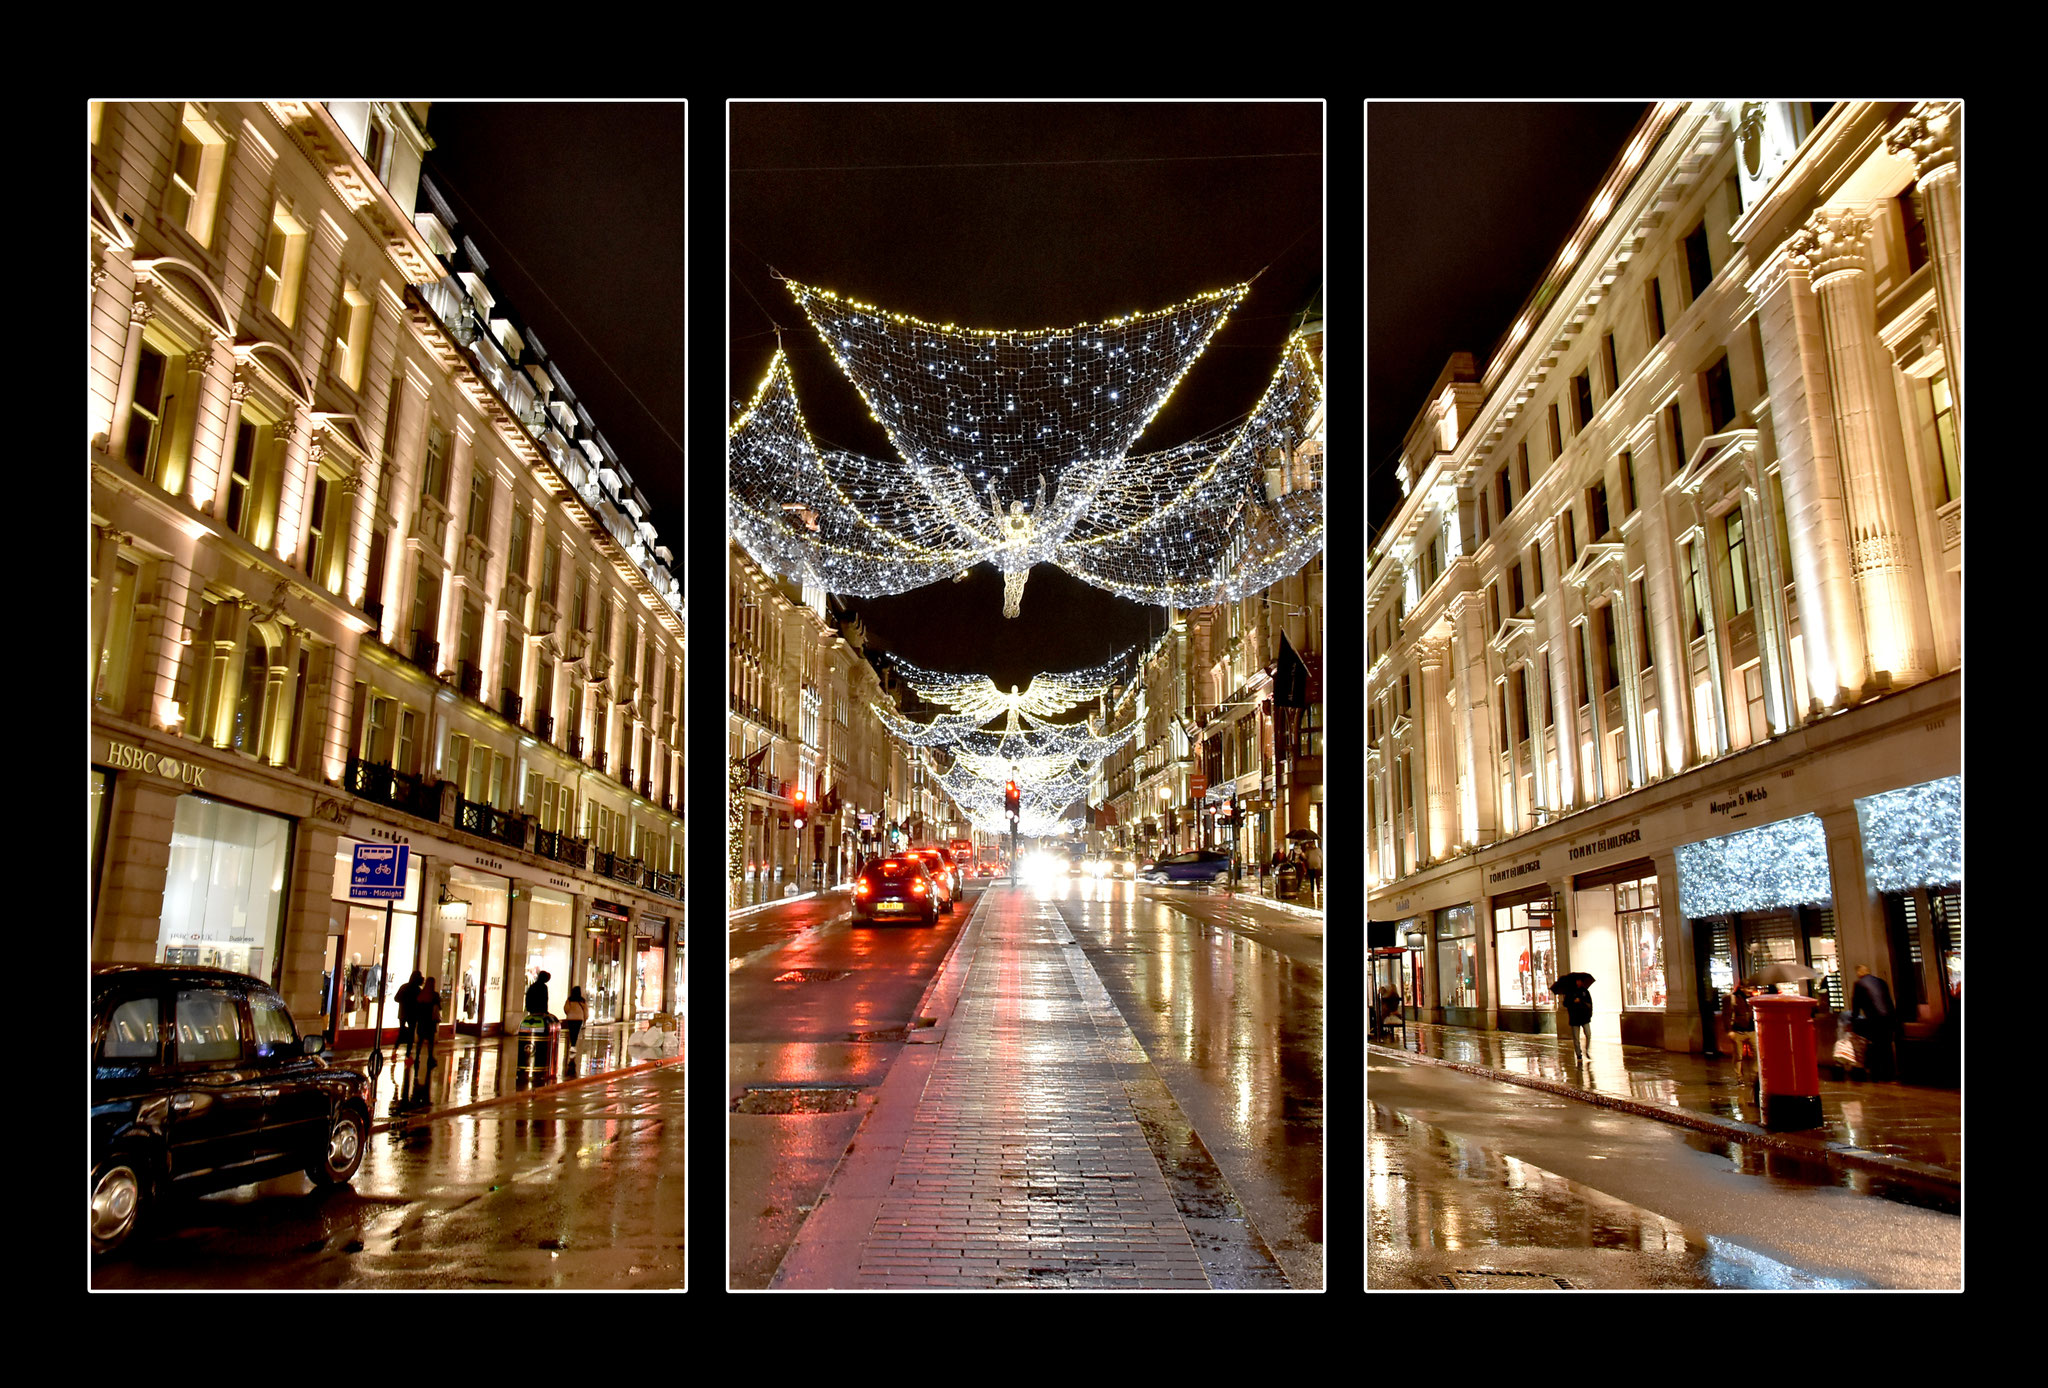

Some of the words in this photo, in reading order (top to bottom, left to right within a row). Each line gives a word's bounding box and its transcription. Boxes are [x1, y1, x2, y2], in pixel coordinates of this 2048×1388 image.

[107, 741, 157, 773] HSBC
[182, 762, 206, 788] UK
[1739, 793, 1745, 806] &
[1745, 786, 1768, 803] Webb
[371, 828, 409, 844] sandro
[1568, 841, 1597, 861] TOMMY
[1606, 828, 1641, 850] HILFIGER
[475, 857, 503, 870] sandro
[1489, 868, 1510, 884] TOMMY
[1516, 859, 1541, 876] HILFIGER
[354, 876, 368, 884] taxi
[549, 878, 570, 888] sandro
[352, 888, 368, 896] 11am
[373, 889, 402, 898] Midnight
